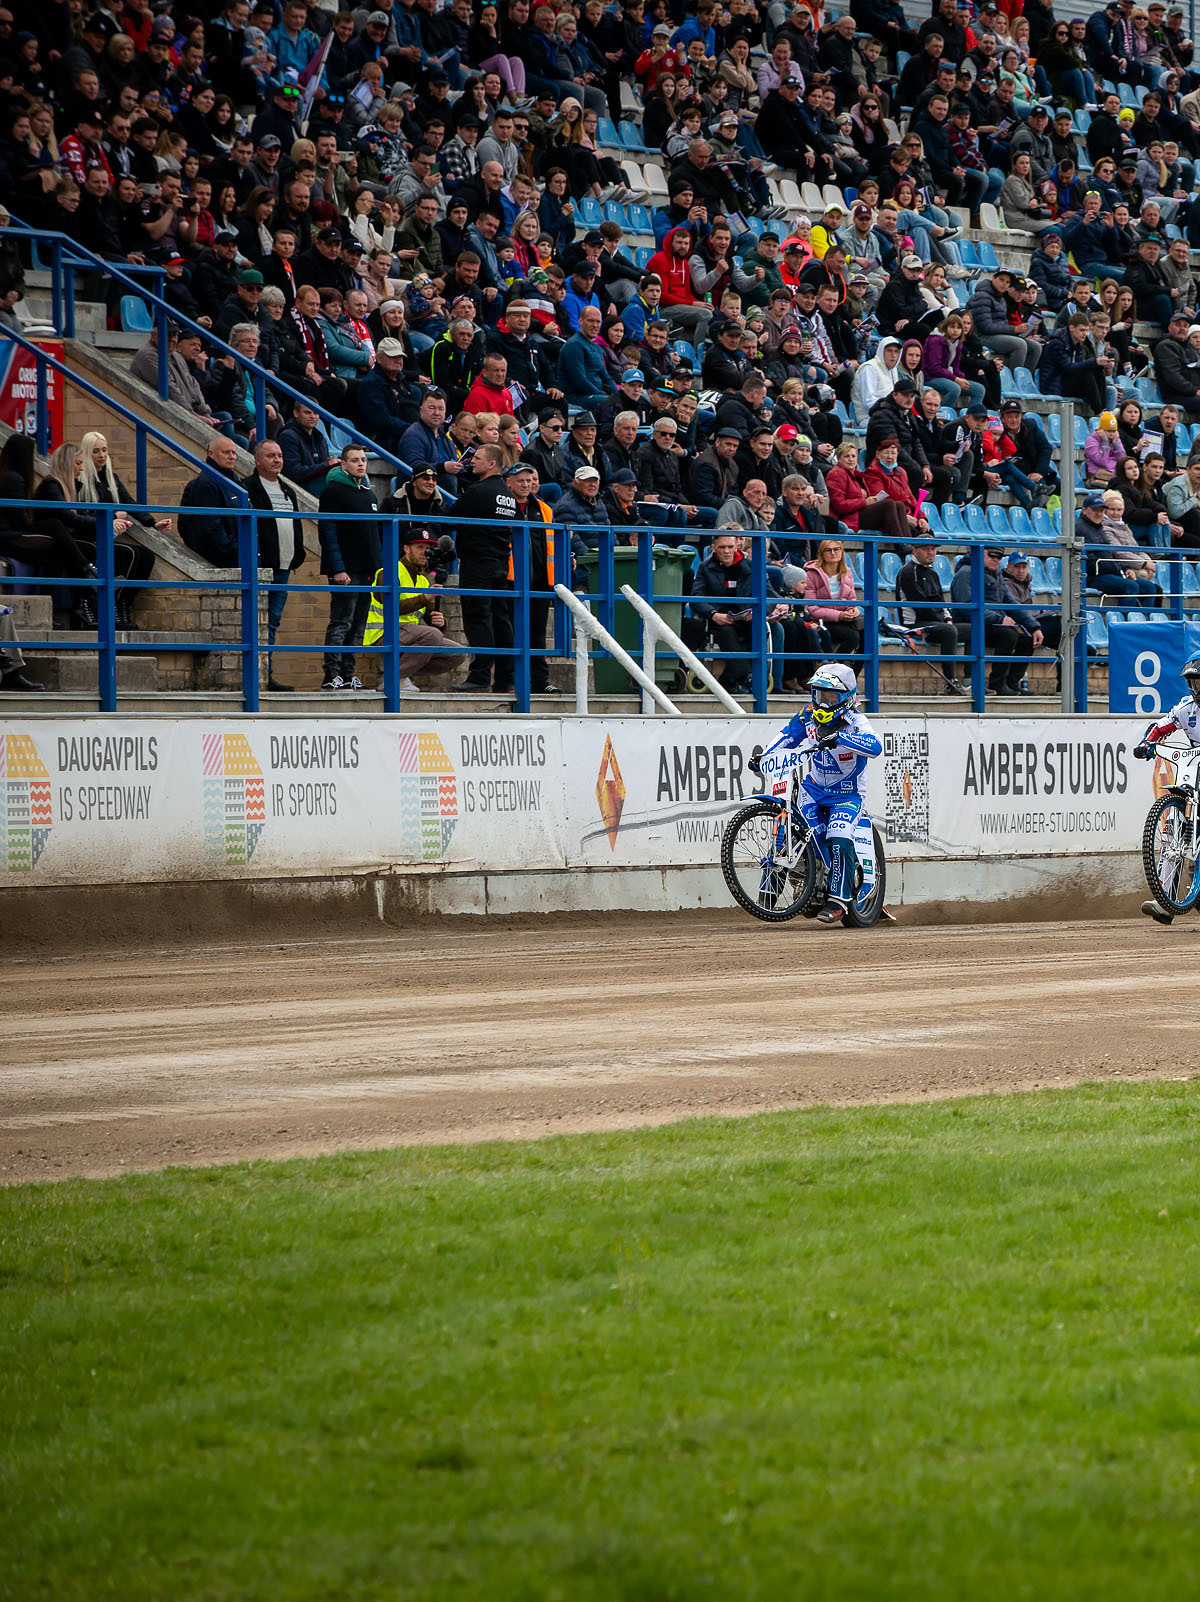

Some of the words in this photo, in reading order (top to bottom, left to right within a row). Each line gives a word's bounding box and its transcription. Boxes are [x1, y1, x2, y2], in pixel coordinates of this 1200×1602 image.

[57, 736, 158, 771] DAUGAVPILS
[270, 736, 359, 769] DAUGAVPILS
[460, 735, 546, 767] DAUGAVPILS
[656, 746, 744, 802] AMBER
[963, 743, 1038, 796] AMBER
[1043, 742, 1128, 795] STUDIOS
[59, 786, 73, 821] IS
[78, 786, 151, 821] SPEEDWAY
[272, 783, 285, 816] IR
[289, 783, 337, 816] SPORTS
[463, 780, 475, 812] IS
[479, 780, 541, 812] SPEEDWAY
[980, 811, 1116, 834] WWW.AMBER-STUDIOS.COM
